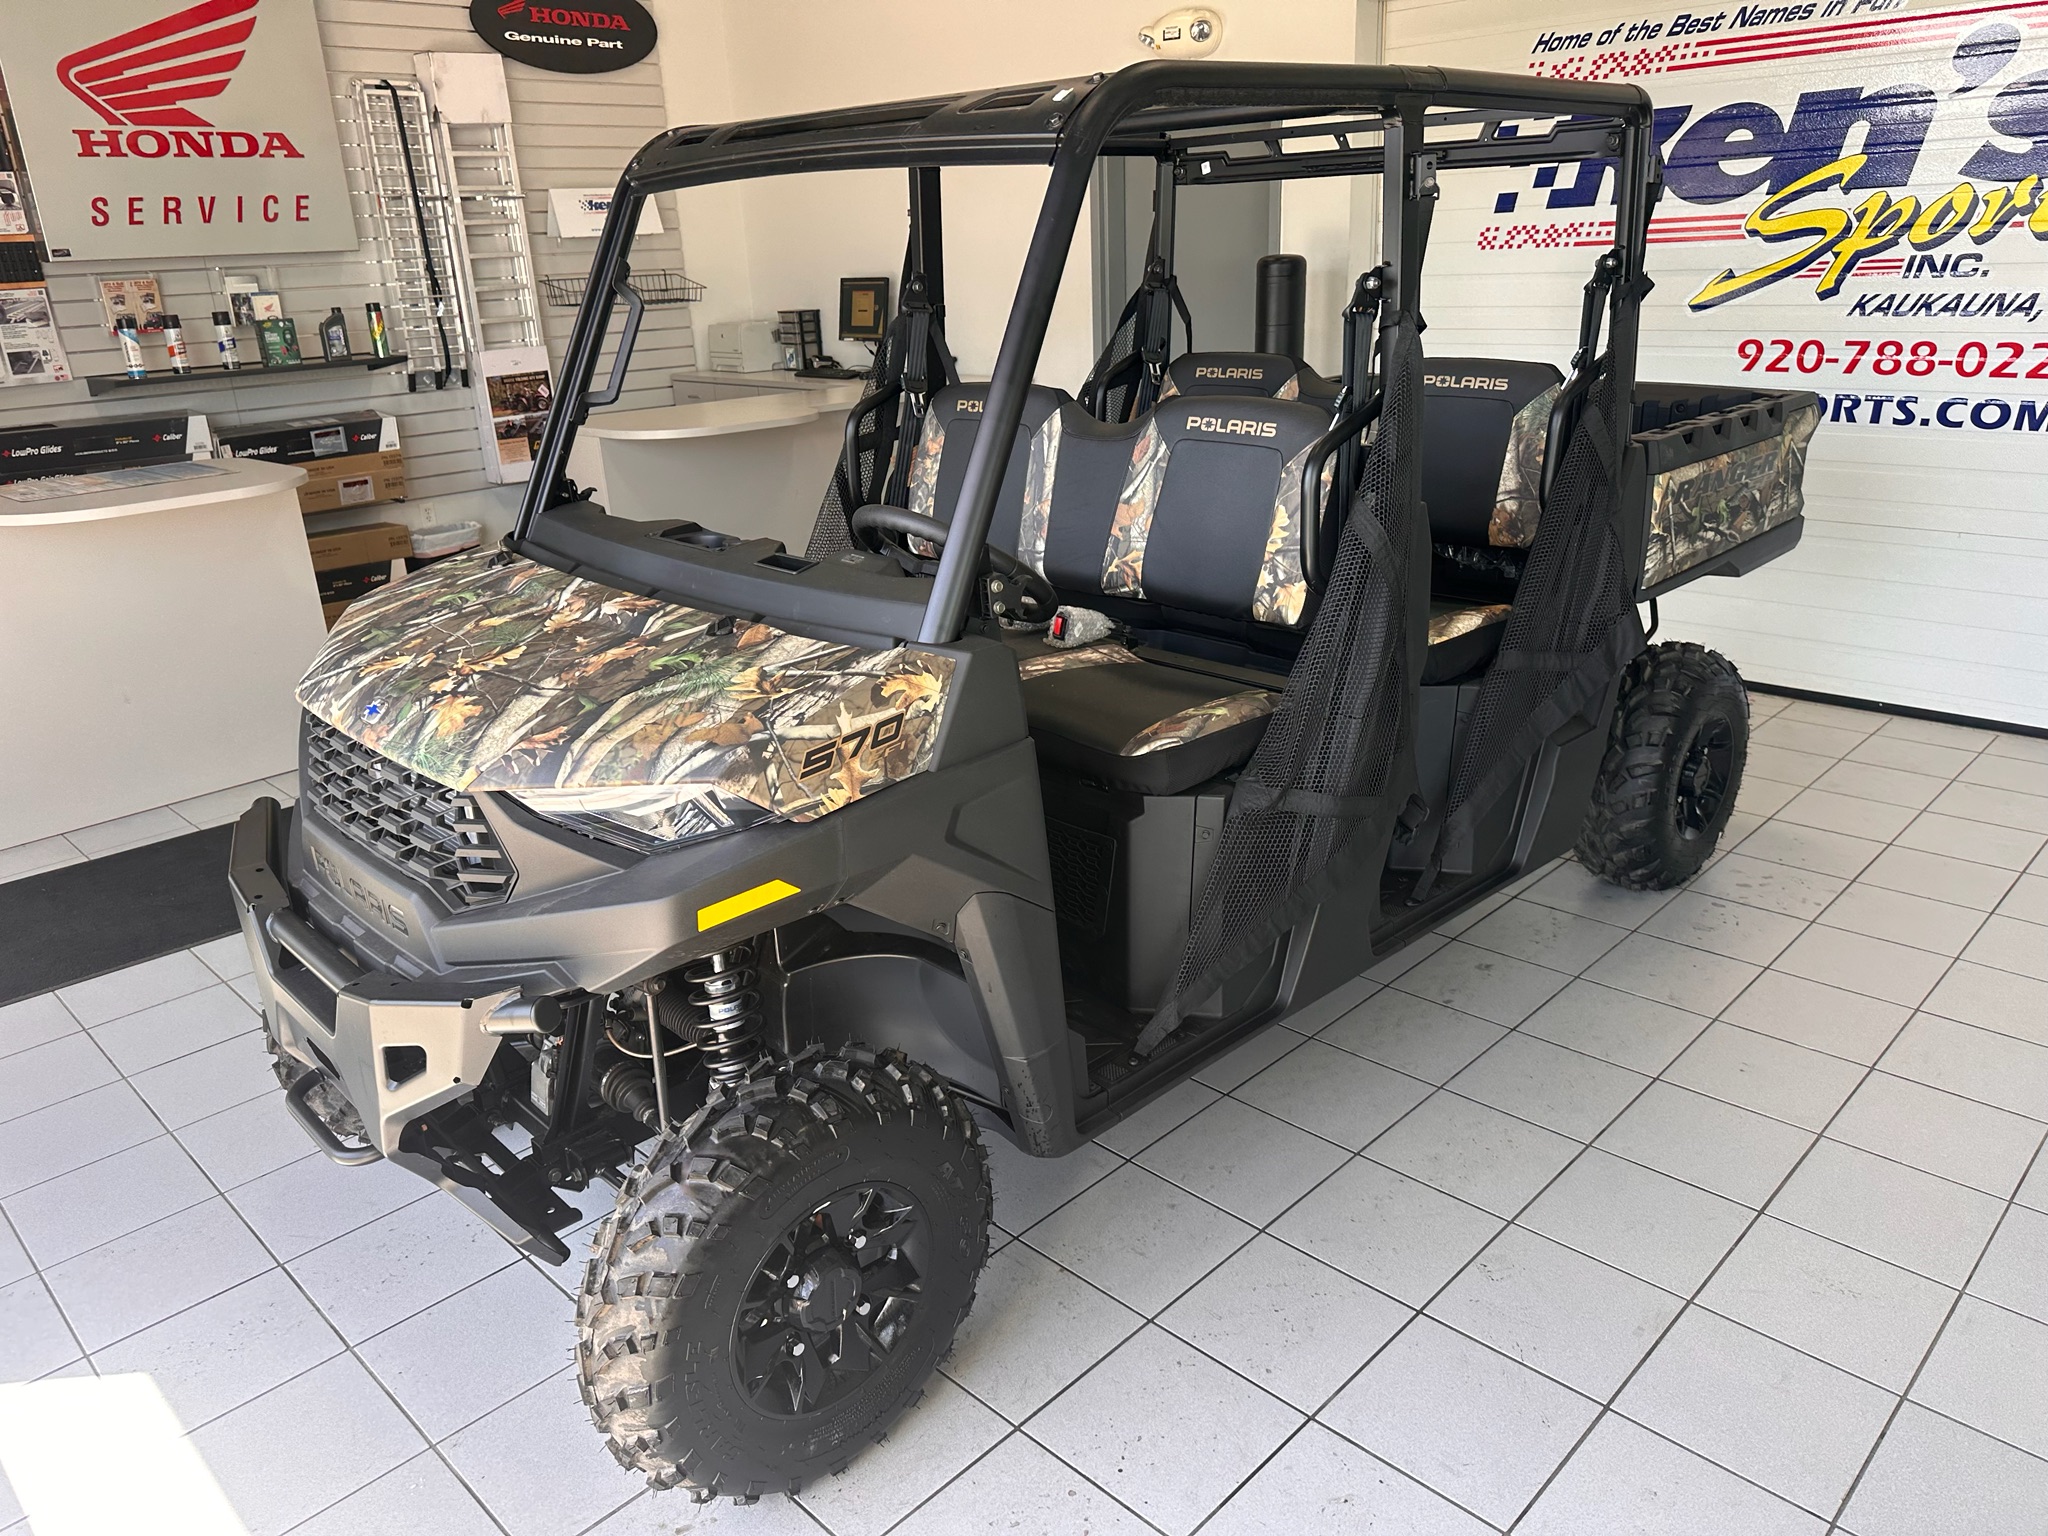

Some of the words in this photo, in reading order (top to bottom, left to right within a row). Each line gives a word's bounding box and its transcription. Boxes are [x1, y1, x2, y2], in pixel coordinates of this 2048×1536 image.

[528, 6, 631, 31] HONDA
[1531, 30, 1592, 54] Home
[1597, 26, 1623, 46] of
[1624, 21, 1659, 41] the
[1666, 13, 1726, 37] Best
[1728, 2, 1817, 31] Names
[504, 30, 583, 46] Genuine
[586, 37, 624, 50] Part
[72, 129, 305, 158] HONDA
[91, 194, 310, 227] SERVICE
[1902, 252, 1991, 280] INC.
[1846, 292, 2044, 323] KAUKAUNA,
[1737, 338, 2048, 379] 920-788-022
[1195, 366, 1264, 380] POLARIS
[1424, 374, 1509, 391] POLARIS
[162, 432, 183, 442] Caliber
[360, 433, 378, 442] Caliber
[1186, 415, 1278, 438] POLARIS
[11, 447, 39, 457] LowPro
[40, 445, 62, 454] Glides
[235, 448, 259, 458] LowPro
[259, 446, 278, 455] Glides
[370, 574, 387, 583] Caliber
[798, 710, 906, 782] 570
[309, 845, 410, 938] POLARIS
